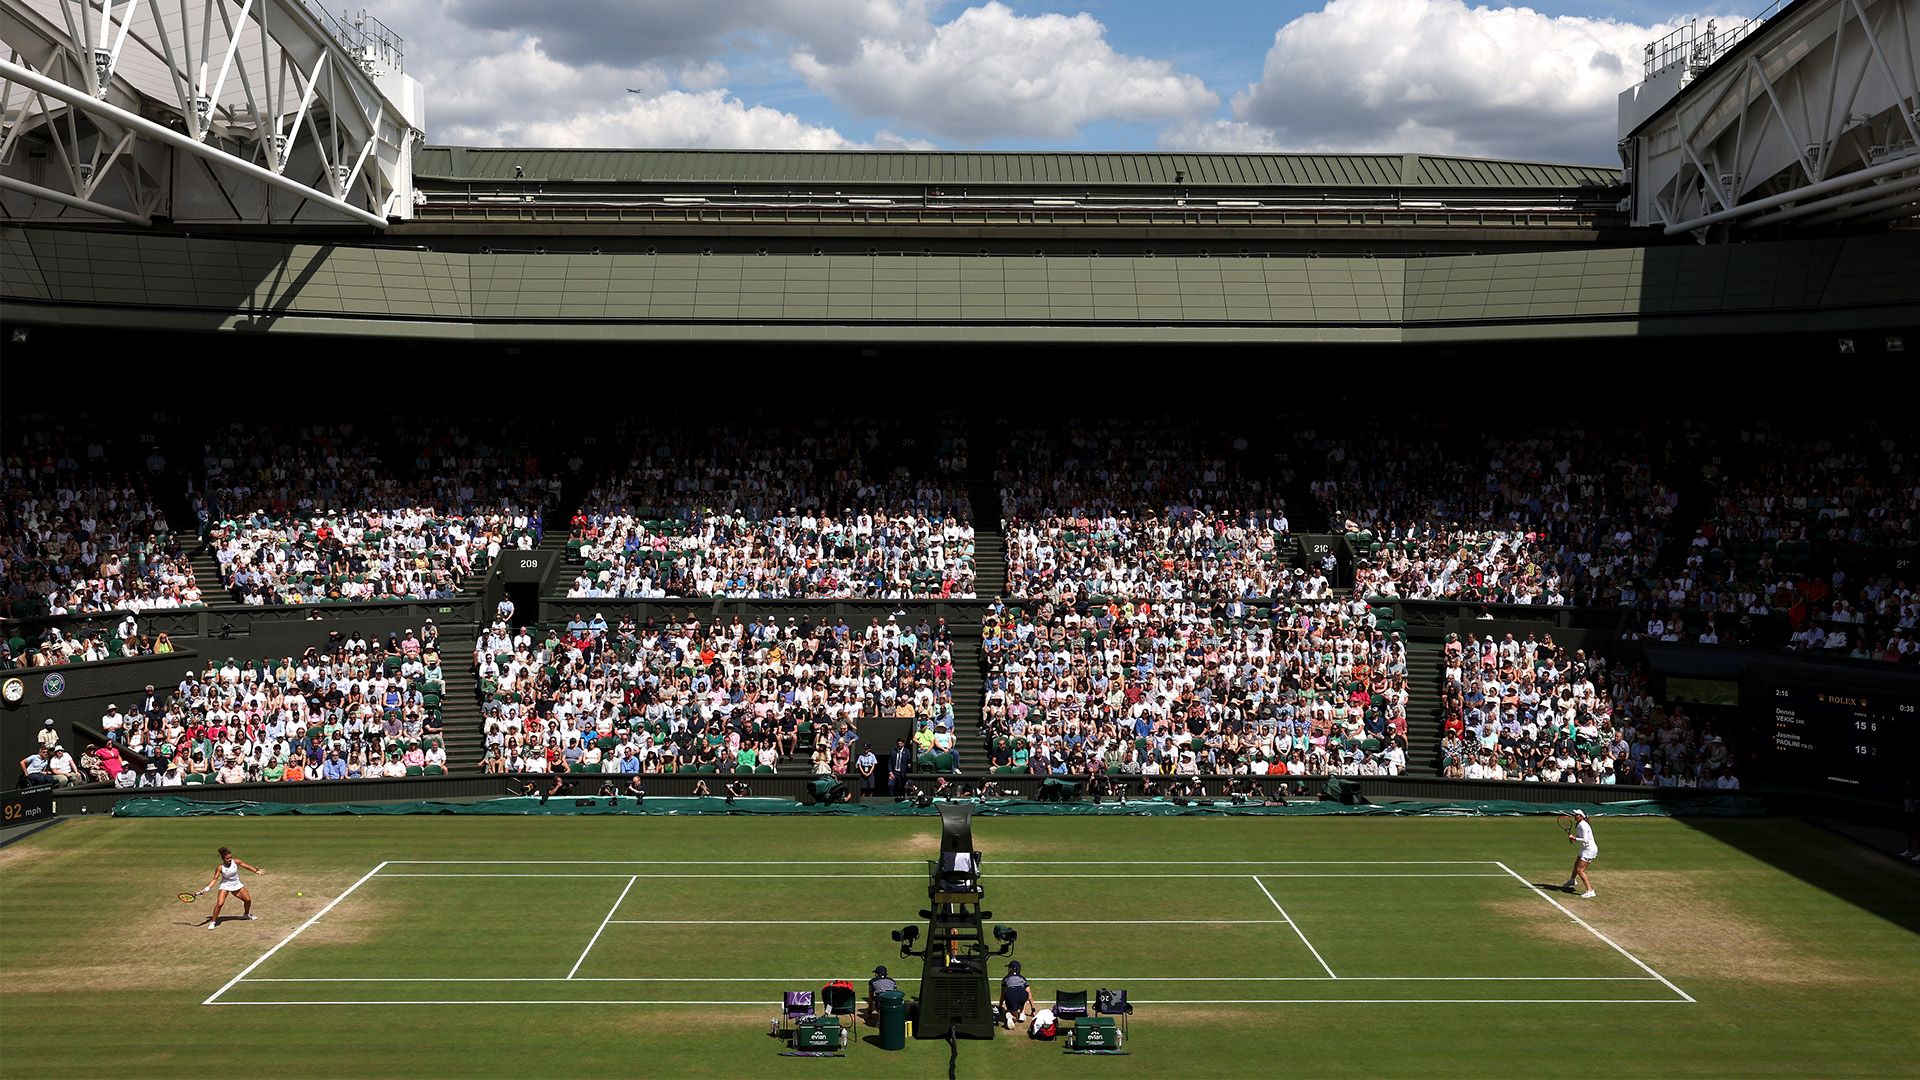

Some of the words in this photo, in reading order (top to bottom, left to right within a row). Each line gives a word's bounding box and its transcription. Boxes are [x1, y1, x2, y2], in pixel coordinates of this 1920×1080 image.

[520, 559, 538, 568] 209
[1776, 689, 1789, 697] 2:16
[1828, 695, 1857, 706] ROLEX
[1776, 707, 1795, 716] Donna
[1899, 704, 1915, 713] 0:38
[1855, 721, 1867, 730] 15
[1871, 722, 1877, 732] 6
[1776, 738, 1800, 748] PAOLINI
[1855, 745, 1867, 755] 15
[1871, 747, 1877, 756] 2
[4, 803, 22, 820] 92
[25, 806, 42, 817] mph
